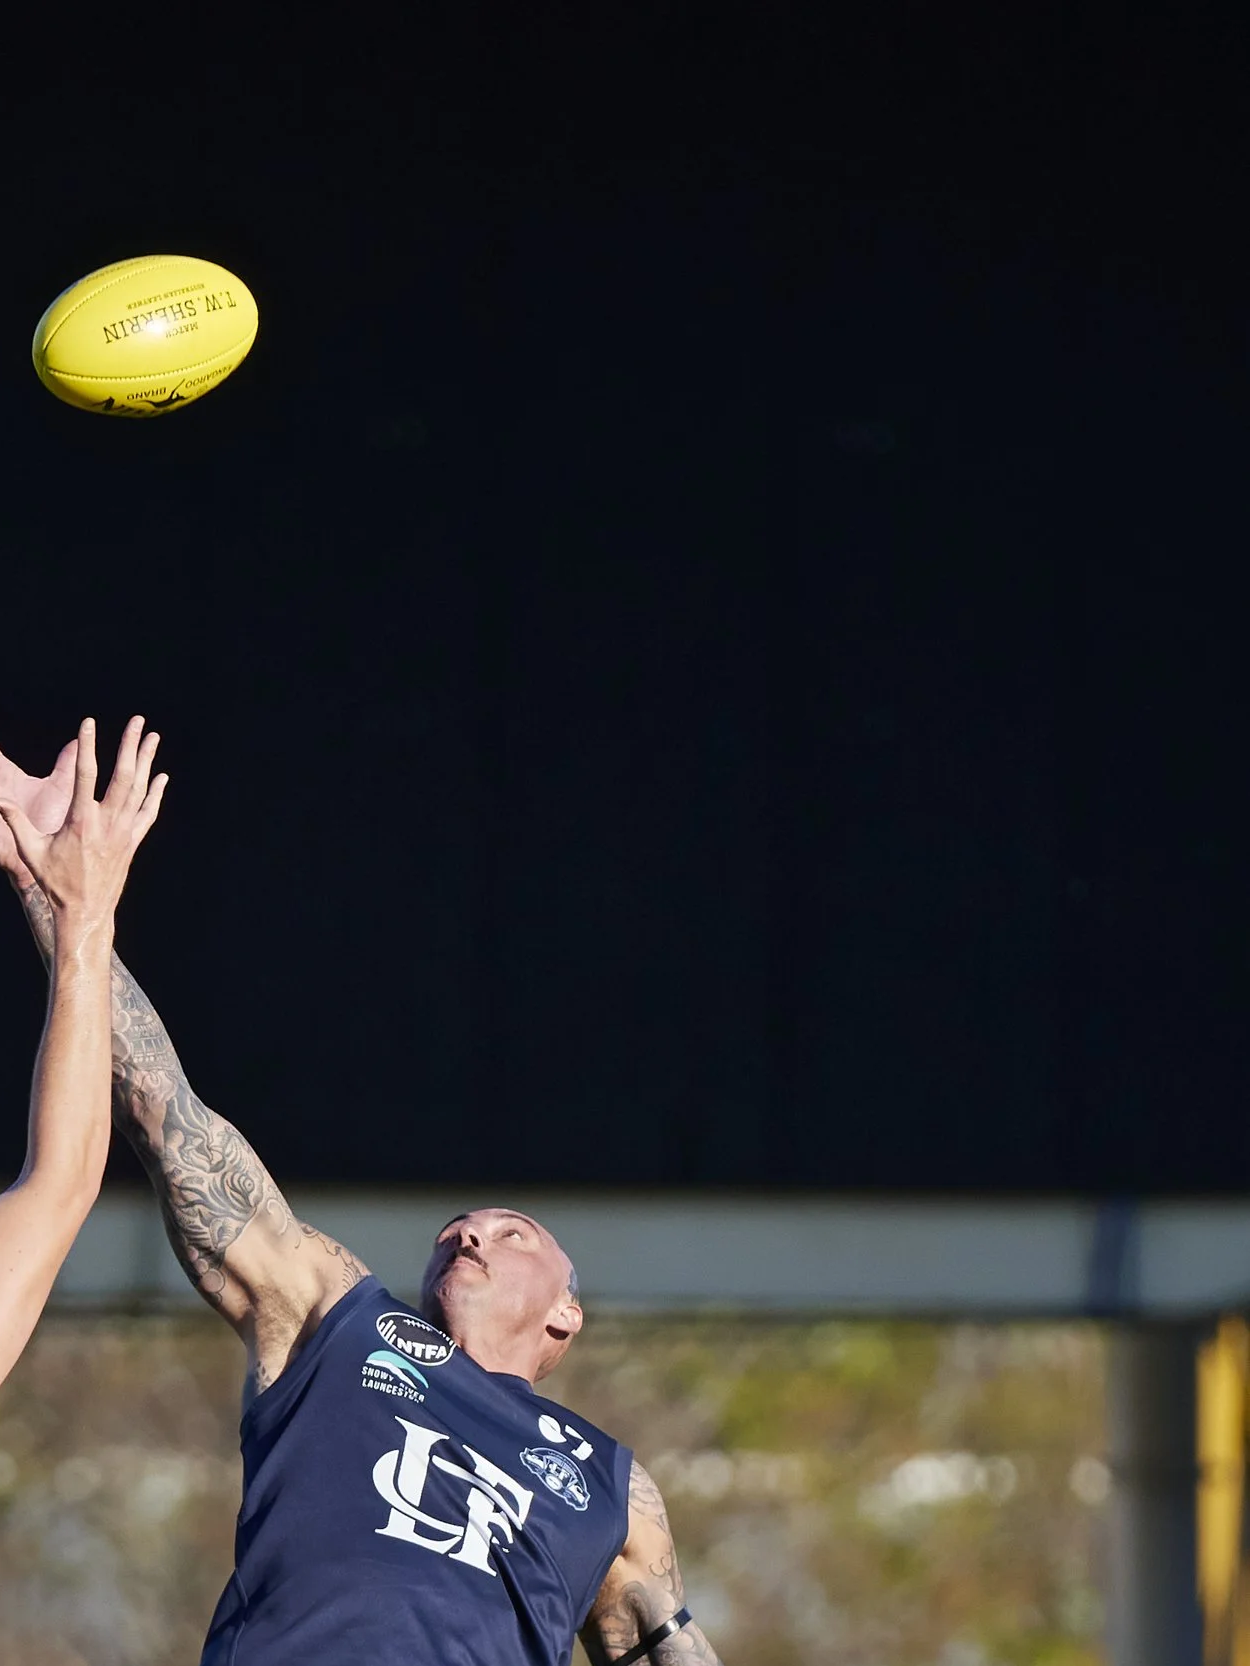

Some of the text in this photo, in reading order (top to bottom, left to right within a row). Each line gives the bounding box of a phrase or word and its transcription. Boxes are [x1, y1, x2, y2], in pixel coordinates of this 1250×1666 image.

[127, 387, 167, 400] BRAND
[396, 1337, 447, 1360] NTFA
[361, 1366, 394, 1382] SNOWY
[362, 1378, 419, 1403] LAUNCESTO
